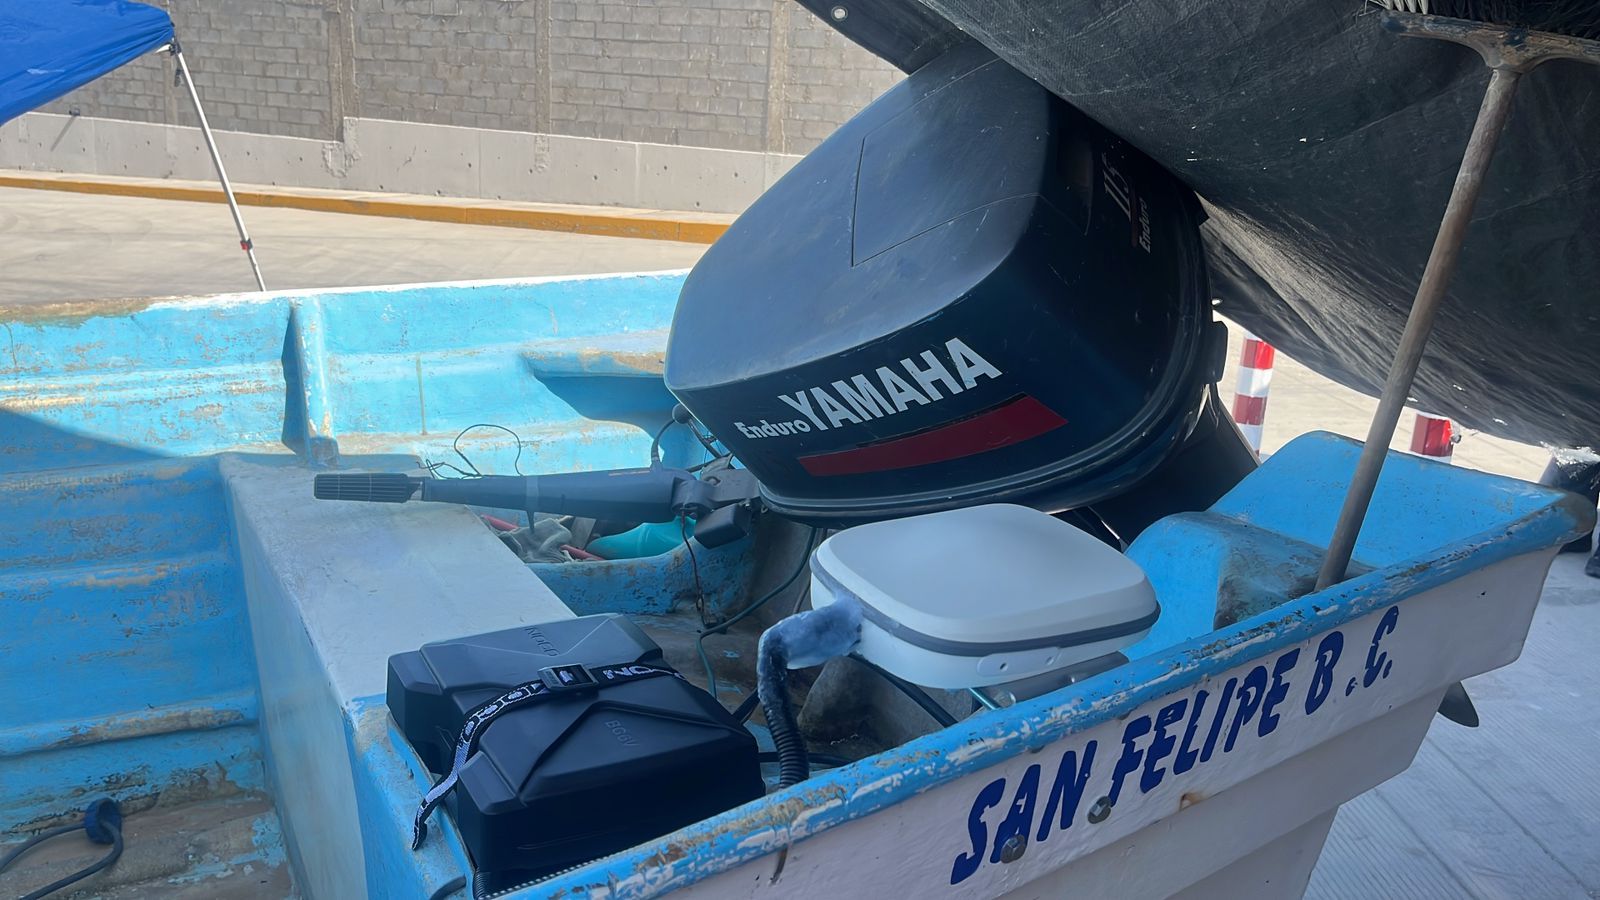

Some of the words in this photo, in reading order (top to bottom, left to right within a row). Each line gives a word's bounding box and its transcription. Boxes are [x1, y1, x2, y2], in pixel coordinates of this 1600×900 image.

[1138, 196, 1151, 253] Enduro
[734, 418, 811, 439] Enduro
[777, 337, 1003, 431] YAMAHA
[950, 740, 1098, 885] SAN
[1110, 648, 1301, 807] FELIPE
